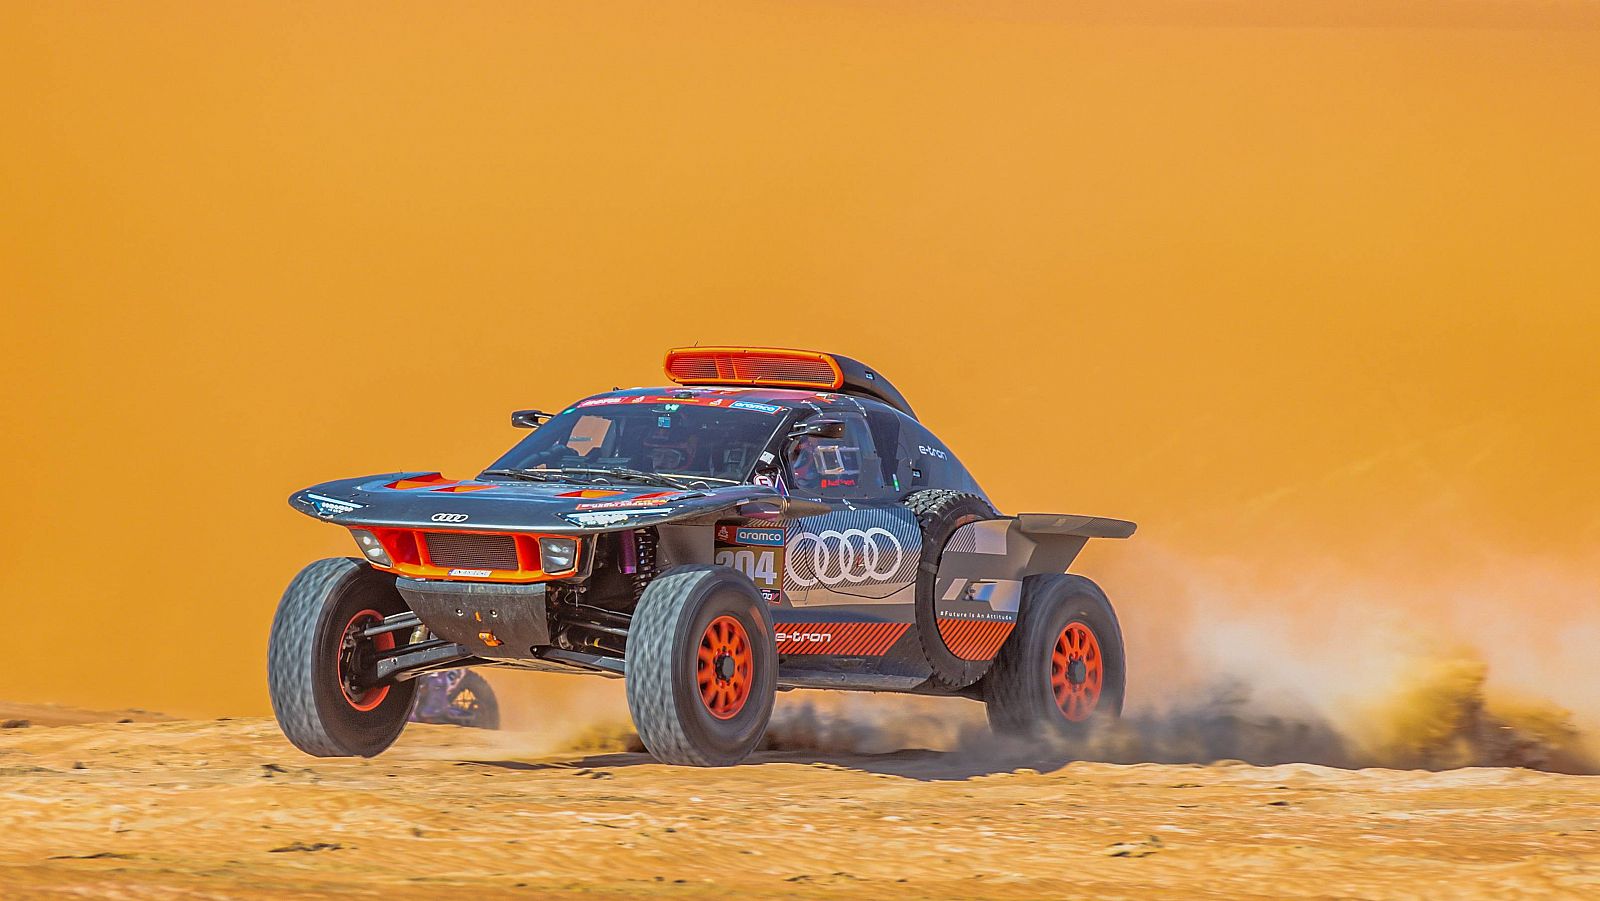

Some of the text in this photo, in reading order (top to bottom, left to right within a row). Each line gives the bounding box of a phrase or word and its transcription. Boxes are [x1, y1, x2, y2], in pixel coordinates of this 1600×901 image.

[734, 402, 776, 412] aramco
[918, 445, 947, 461] e-tron
[739, 531, 781, 541] aramco
[775, 631, 832, 642] e-tron
